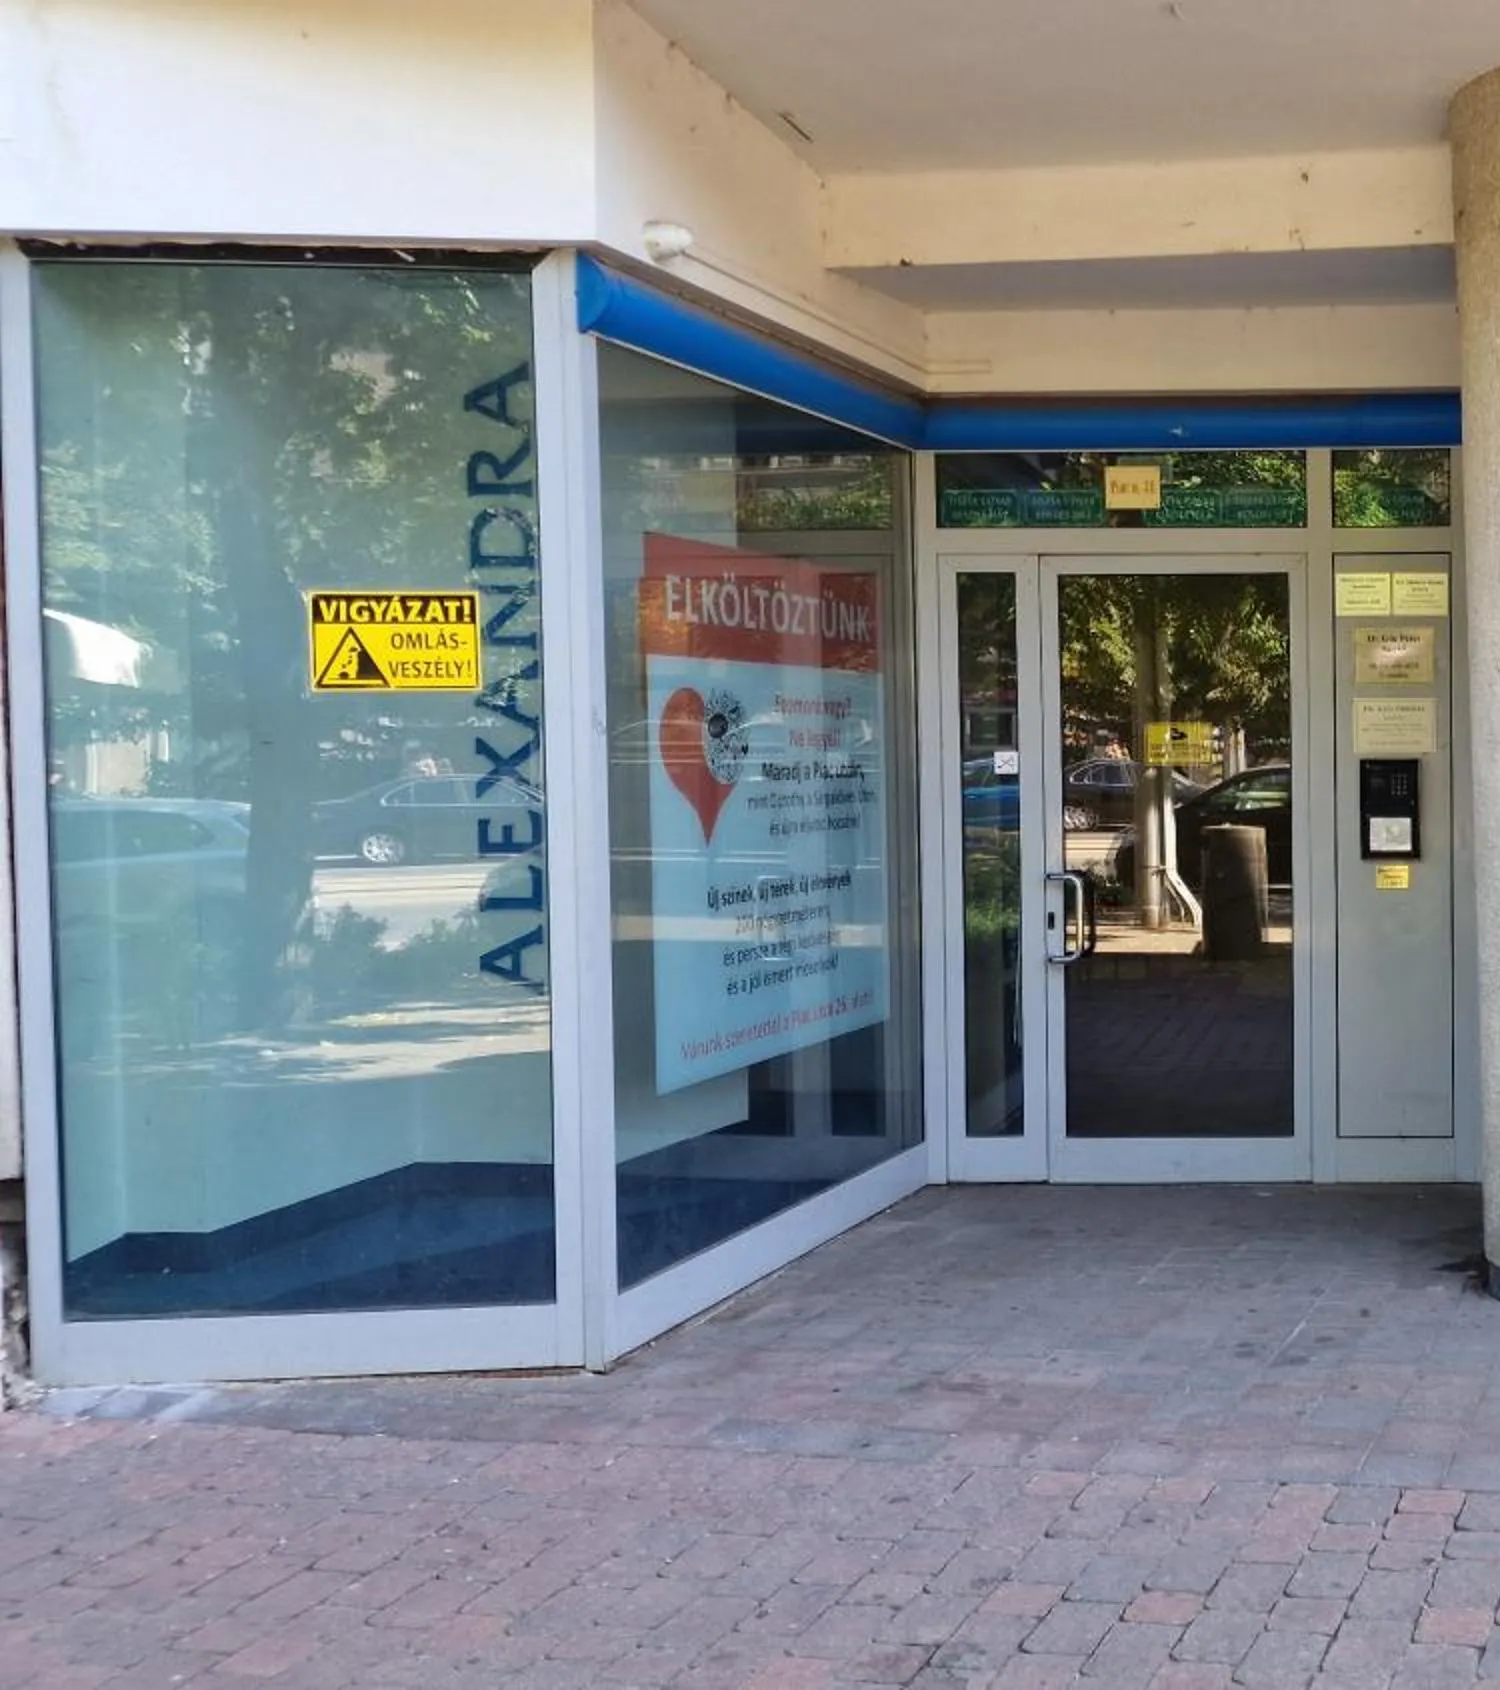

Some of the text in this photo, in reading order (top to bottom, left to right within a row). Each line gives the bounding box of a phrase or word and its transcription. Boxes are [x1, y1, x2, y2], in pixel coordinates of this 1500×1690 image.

[318, 596, 472, 622] VIGYÁZAT!
[664, 572, 870, 641] ELKÖLTÖZTÜNK
[390, 629, 468, 650] OMLÁS-
[388, 656, 472, 679] VESZÉLY!
[463, 362, 546, 995] ALEXANDRA
